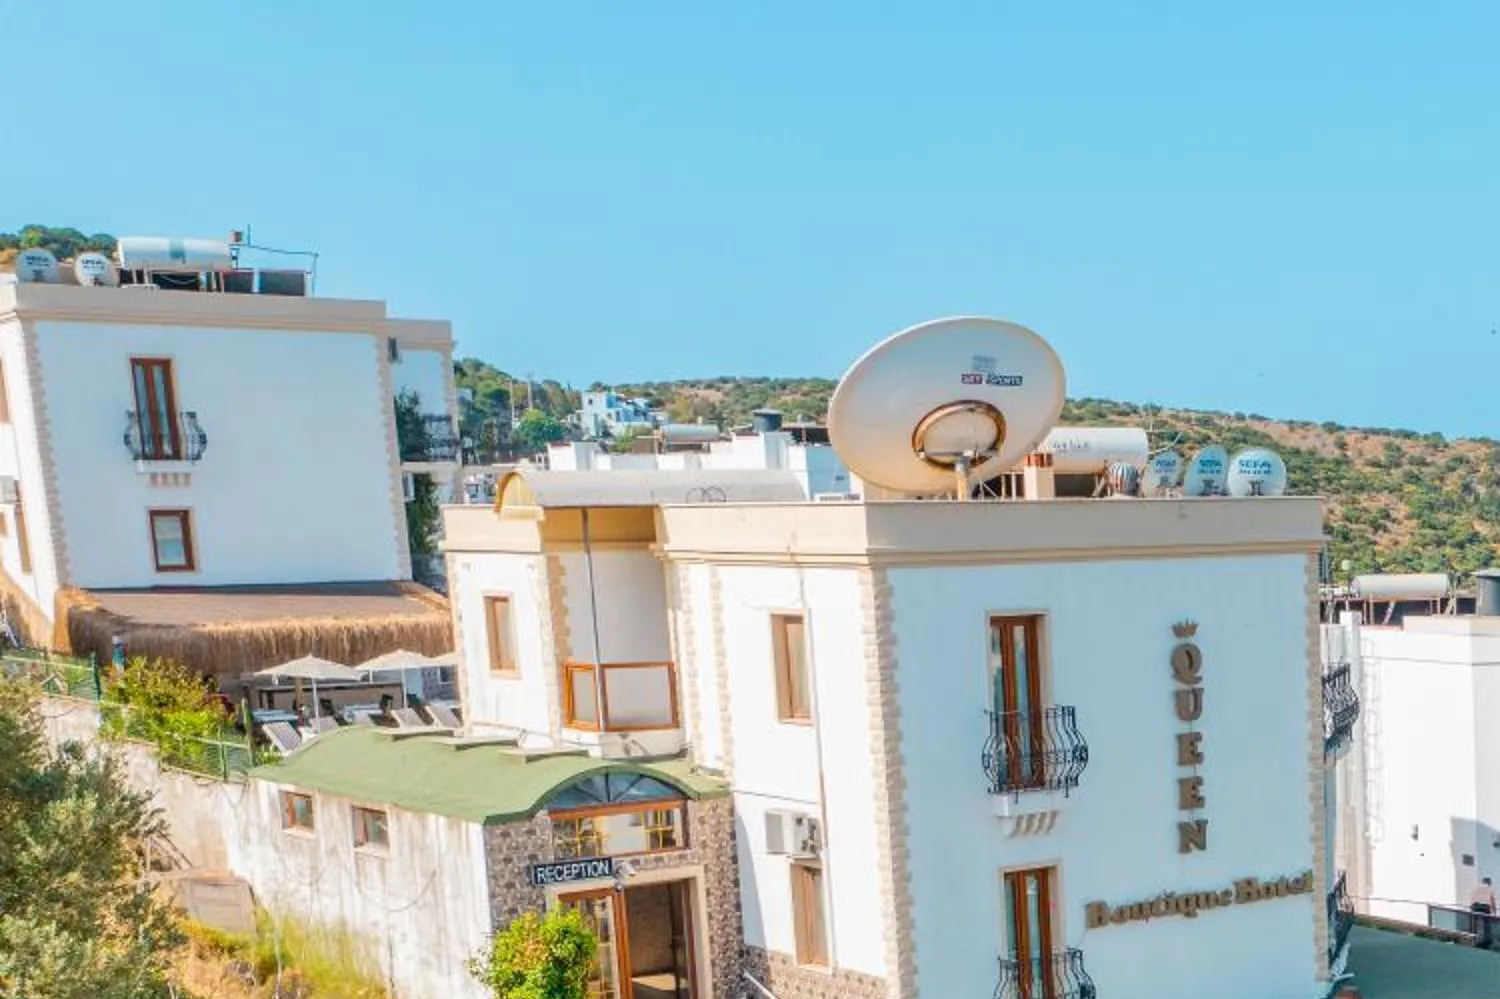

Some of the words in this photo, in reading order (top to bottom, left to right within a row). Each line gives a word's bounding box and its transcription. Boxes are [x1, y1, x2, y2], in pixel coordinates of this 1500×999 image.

[1171, 643, 1208, 854] QUEEN
[536, 860, 609, 883] RECEPTION
[1085, 888, 1232, 929] Boutique
[1233, 869, 1314, 905] Hotel
